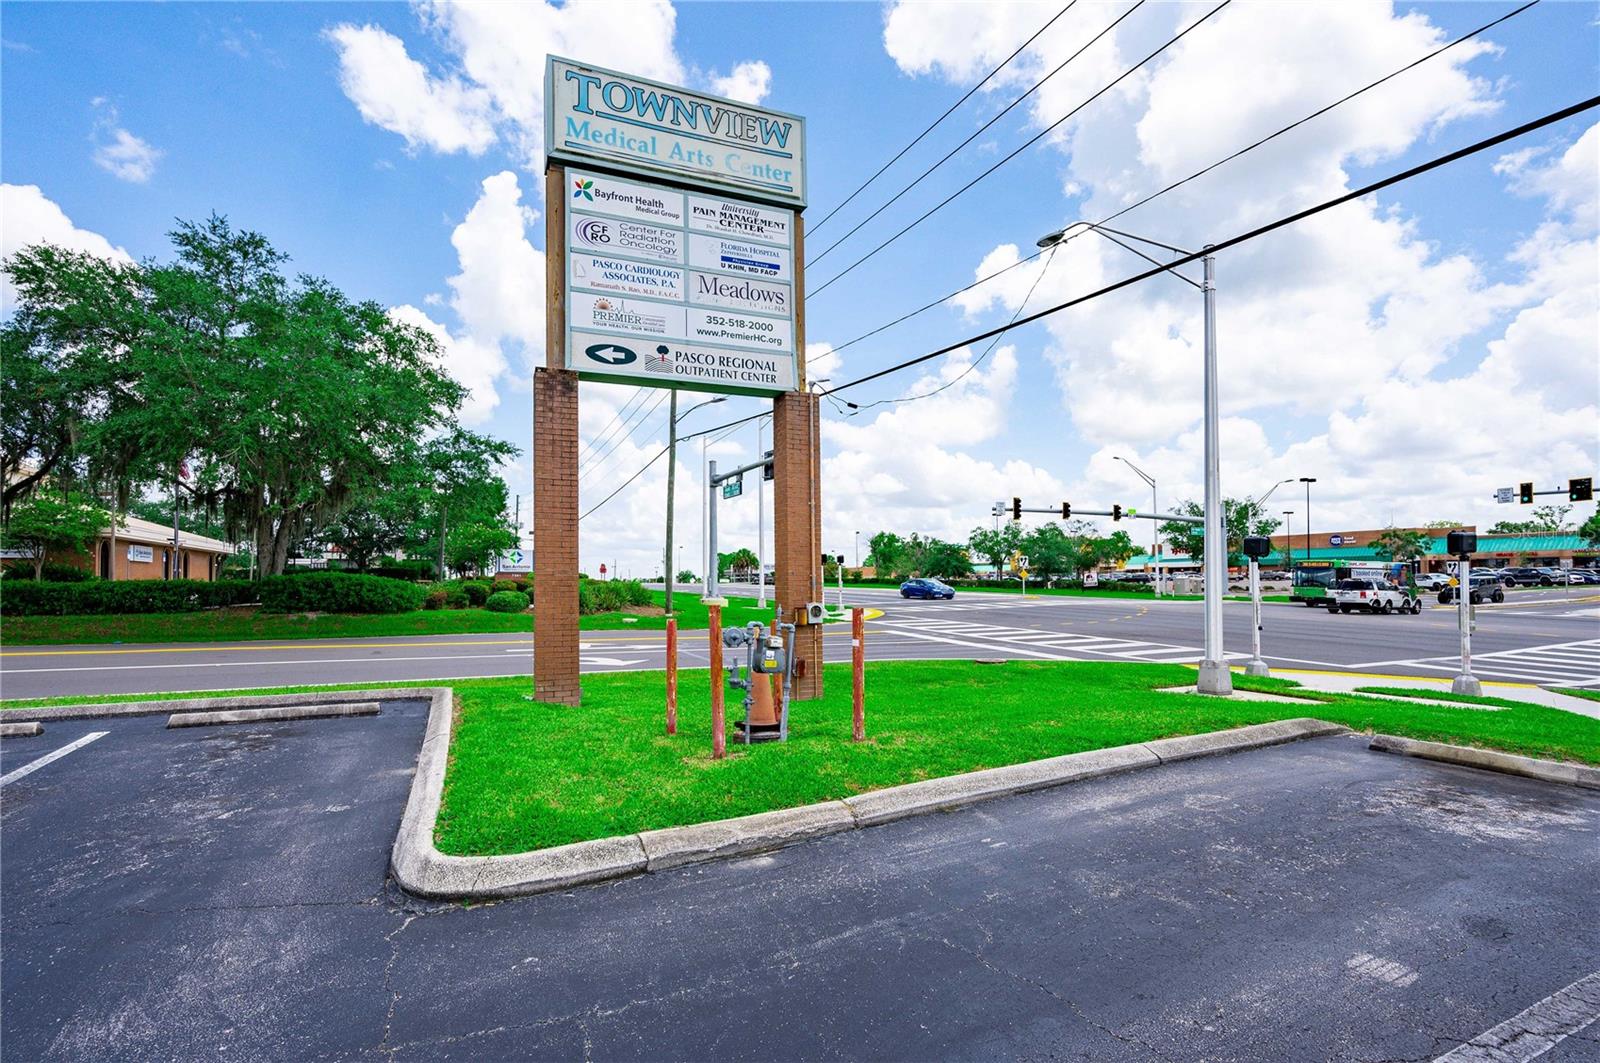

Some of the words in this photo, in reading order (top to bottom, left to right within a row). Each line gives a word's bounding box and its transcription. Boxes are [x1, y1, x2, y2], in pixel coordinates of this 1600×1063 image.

[566, 70, 792, 148] TOWNVIEW
[566, 116, 656, 156] Medical
[668, 142, 714, 168] Arts
[725, 153, 792, 183] Center
[594, 188, 633, 203] Bayfront
[635, 196, 664, 208] Health
[636, 206, 660, 215] Medical
[660, 210, 680, 220] Group
[693, 206, 716, 217] PAIN
[720, 212, 786, 230] MANAGEMENT
[722, 203, 760, 217] University
[590, 224, 608, 234] CF
[619, 223, 657, 235] Center
[720, 219, 764, 233] CENTER
[590, 233, 610, 243] RO
[620, 231, 675, 245] Radiation
[619, 238, 678, 255] Oncology
[721, 242, 748, 252] FLORIDA
[749, 247, 780, 258] HOSPITAL
[592, 260, 622, 270] PASCO
[625, 264, 681, 279] CARDIOLOGY
[728, 263, 747, 272] KHIN,
[761, 268, 778, 276] FACP
[602, 272, 659, 286] ASSOCIATES,
[661, 280, 676, 288] P.A.
[698, 275, 785, 305] Meadows
[593, 311, 642, 325] PREMIER
[706, 316, 773, 332] 352-518-2000
[697, 329, 782, 346] www.PremierHC.org
[675, 351, 716, 365] PASCO
[718, 356, 777, 372] REGIONAL
[675, 364, 739, 380] OUTPATIENT
[740, 372, 777, 384] CENTER
